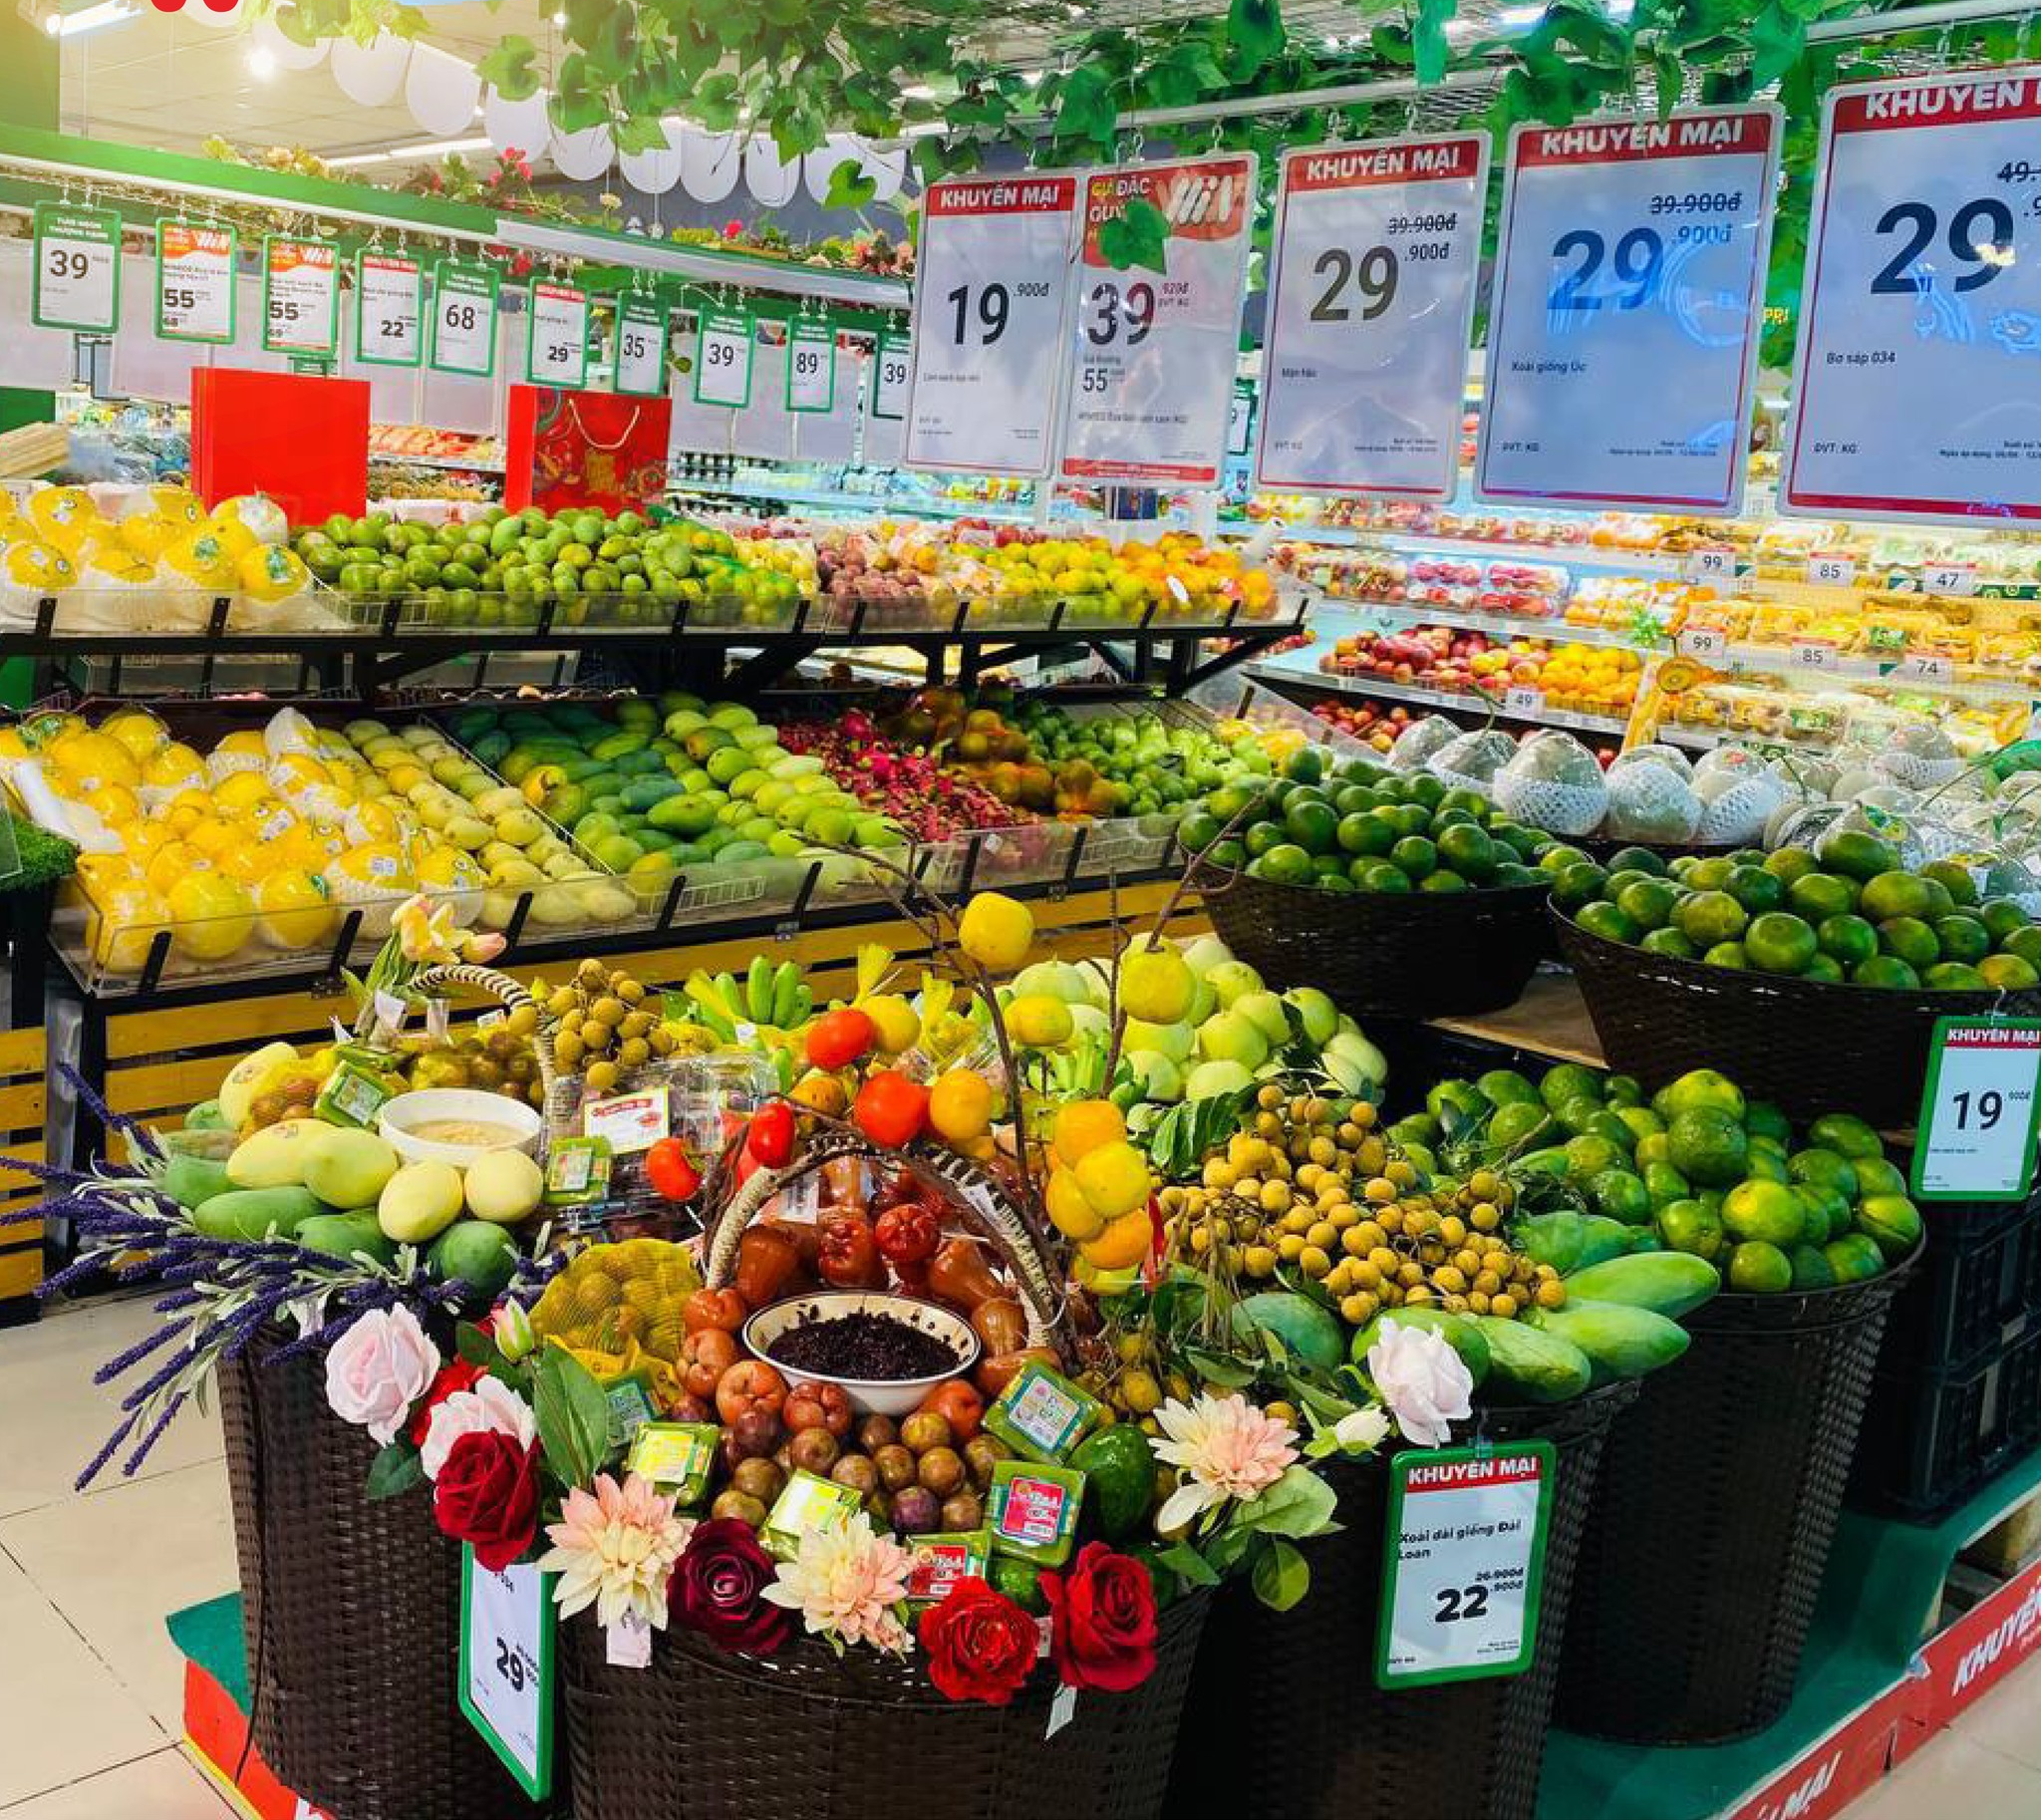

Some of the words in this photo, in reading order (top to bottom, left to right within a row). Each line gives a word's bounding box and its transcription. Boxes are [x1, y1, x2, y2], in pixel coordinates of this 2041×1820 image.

[1679, 119, 1743, 150] MẠI
[1306, 147, 1406, 181] KHUYẾN
[1413, 147, 1460, 175] MẠI
[1021, 184, 1059, 208] MẠI
[1871, 198, 2014, 294] 29
[49, 249, 88, 279] 39
[1547, 227, 1663, 309] 29
[1310, 245, 1399, 321] 29
[163, 289, 194, 308] 55
[269, 301, 299, 320] 55
[445, 304, 476, 330] 68
[950, 282, 1010, 345] 19
[1087, 282, 1155, 345] 39
[381, 320, 404, 338] 22
[547, 346, 568, 362] 29
[624, 334, 644, 358] 35
[709, 343, 734, 367] 39
[796, 352, 817, 373] 89
[884, 362, 906, 385] 39
[1083, 367, 1108, 393] 55
[1703, 555, 1722, 571] 99
[1820, 564, 1841, 579] 85
[1936, 572, 1959, 587] 47
[1803, 650, 1824, 665] 85
[1916, 660, 1937, 675] 74
[1953, 1089, 2003, 1130] 19
[1500, 1456, 1537, 1477] MẠI
[1435, 1584, 1489, 1624] 22
[496, 1636, 524, 1692] 29
